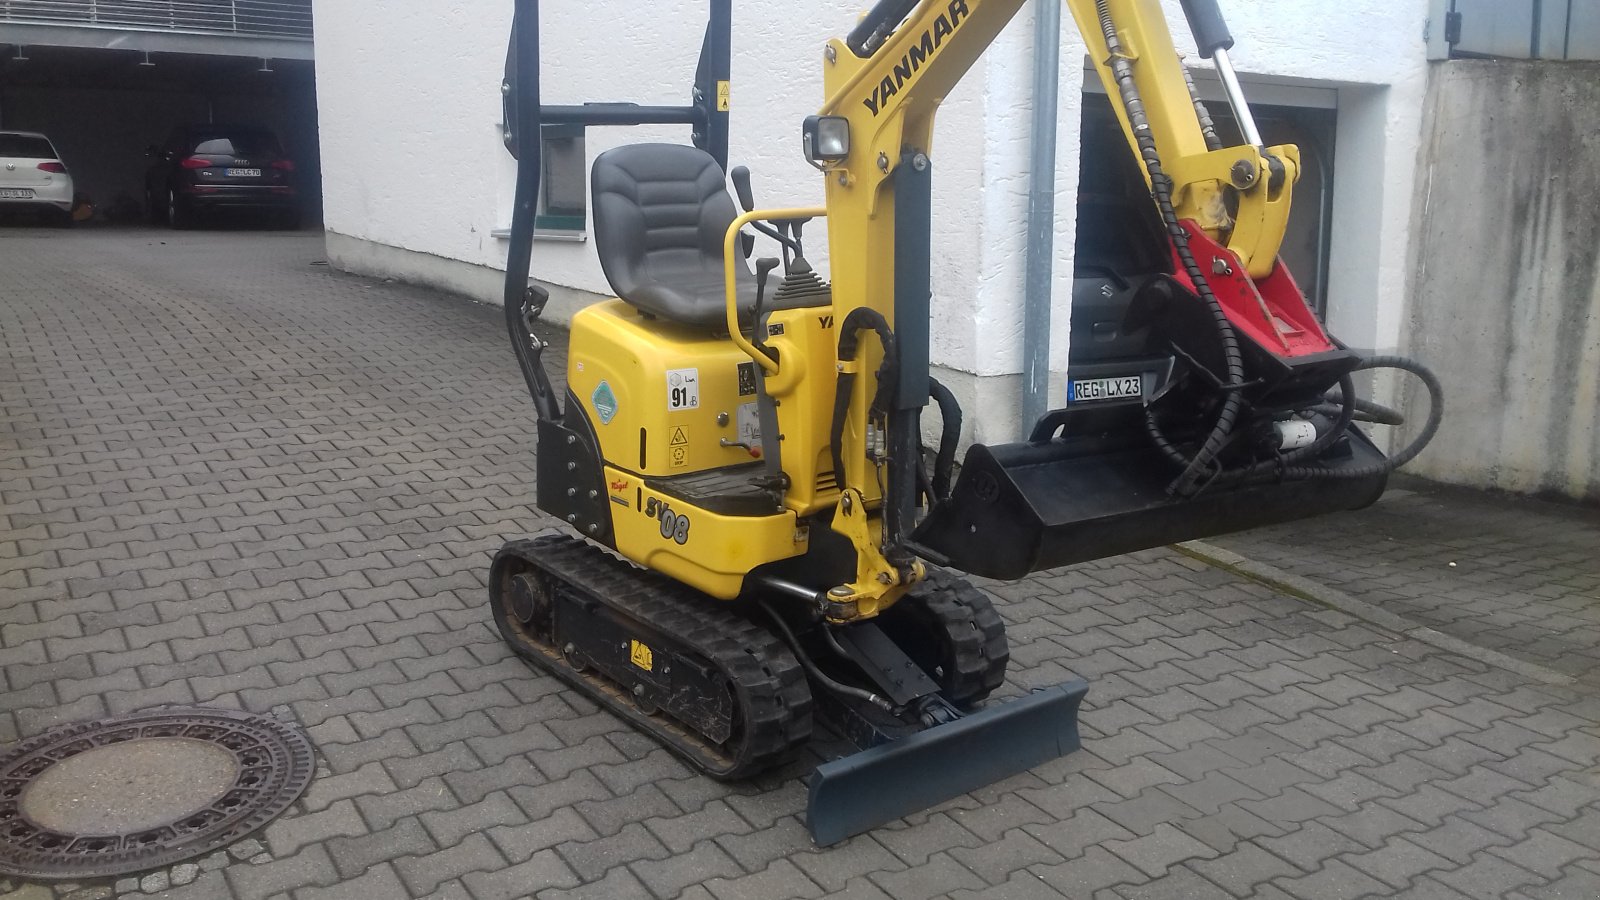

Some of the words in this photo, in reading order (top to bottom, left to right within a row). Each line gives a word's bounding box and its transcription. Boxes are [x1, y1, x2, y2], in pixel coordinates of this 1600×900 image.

[863, 0, 969, 117] YANMAR
[672, 387, 687, 407] 91
[1075, 382, 1099, 399] REG
[1107, 380, 1123, 396] LX
[1125, 379, 1139, 395] 23
